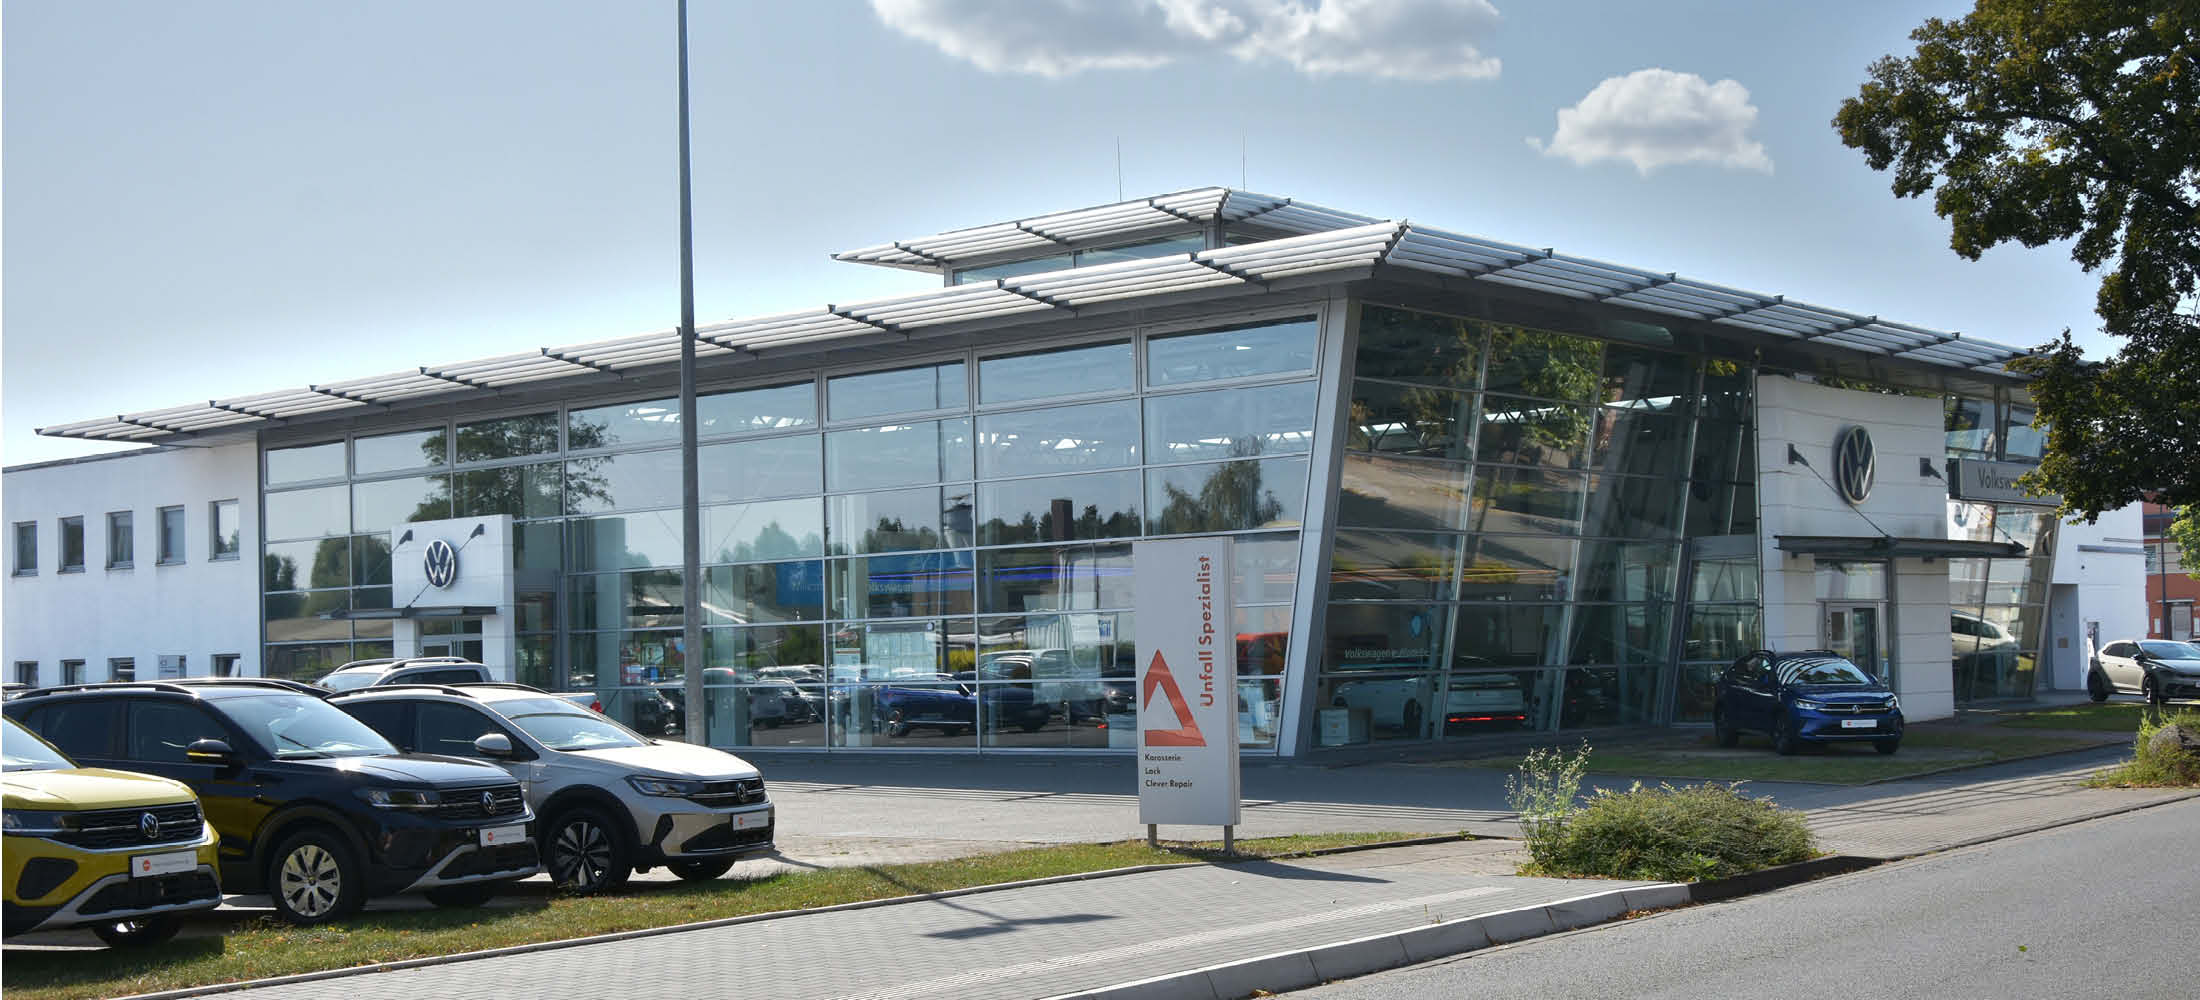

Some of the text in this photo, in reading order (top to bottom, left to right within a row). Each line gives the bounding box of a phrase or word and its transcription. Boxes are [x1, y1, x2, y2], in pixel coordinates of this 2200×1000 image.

[1839, 425, 1876, 504] VW
[1977, 465, 2025, 491] Volksw
[424, 539, 455, 590] VW
[1196, 556, 1215, 707] Unfall Spezialist
[1144, 753, 1181, 761] Karosserie
[1145, 767, 1161, 775] Lack
[1145, 779, 1193, 788] Clever Repair
